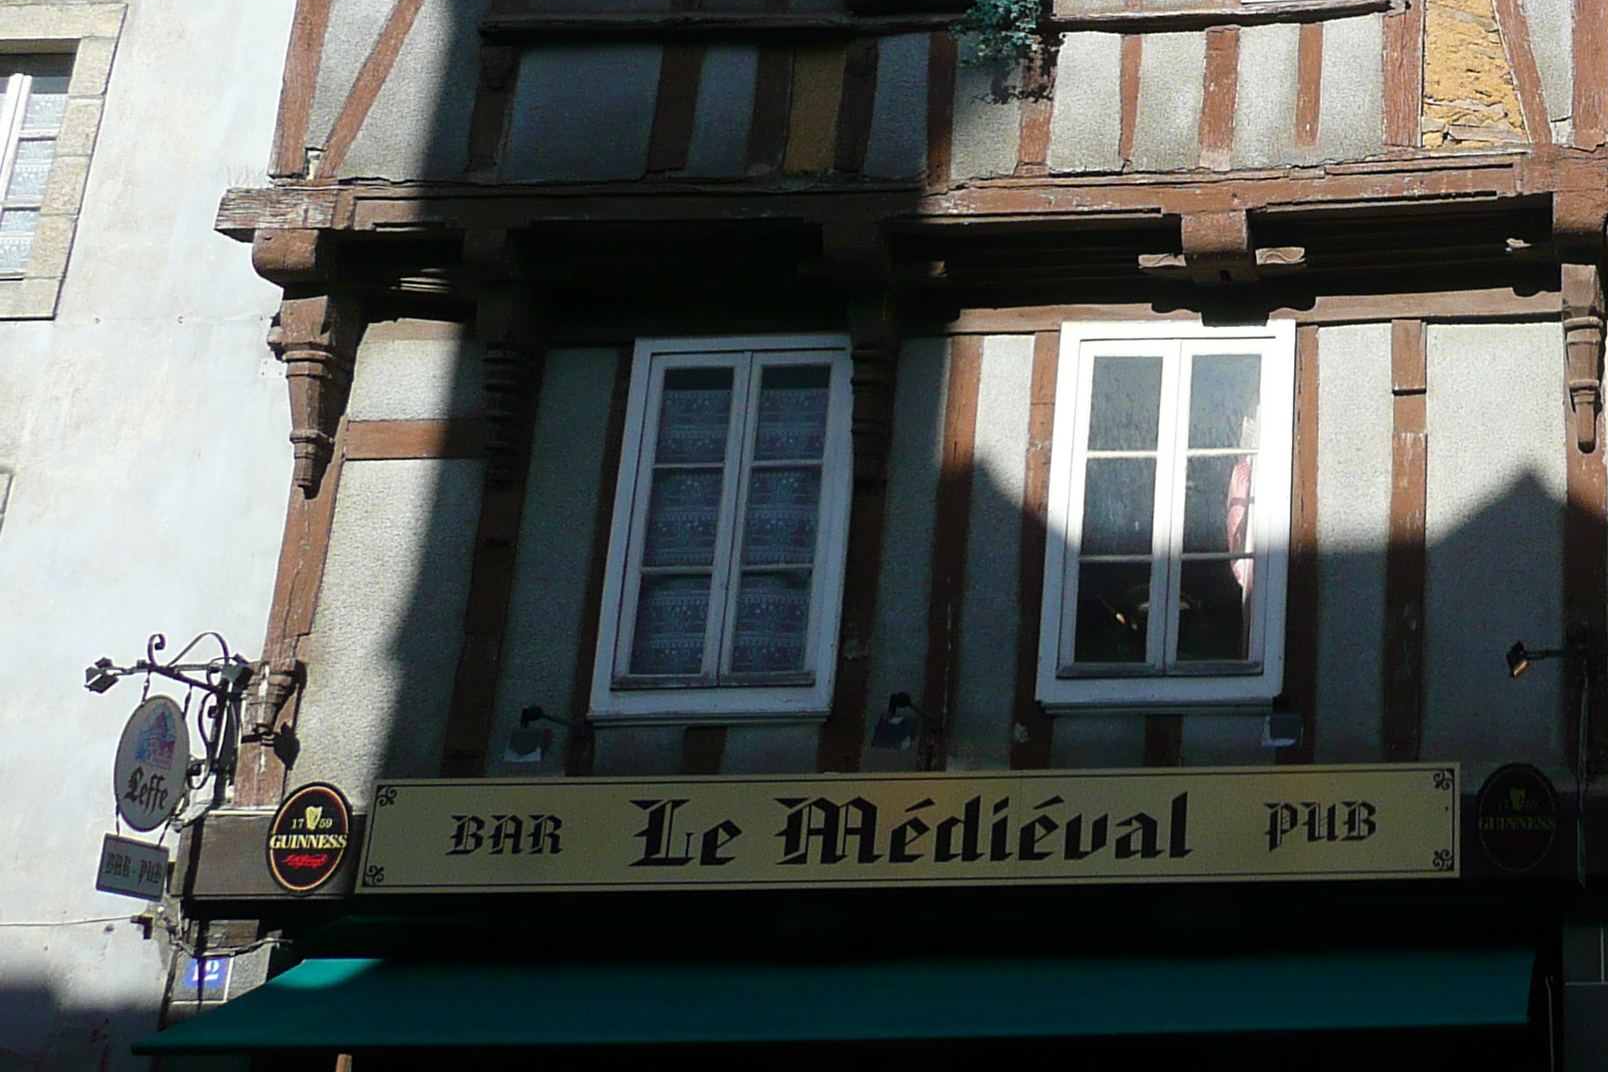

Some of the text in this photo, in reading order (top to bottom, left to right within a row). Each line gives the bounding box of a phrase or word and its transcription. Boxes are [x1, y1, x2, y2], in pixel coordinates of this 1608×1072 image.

[124, 766, 169, 814] Leffe
[445, 790, 1377, 867] BAR Le Médiéval PUB
[1478, 815, 1557, 830] GUINNESS
[270, 834, 347, 849] GUINNESS
[105, 852, 131, 878] BAR
